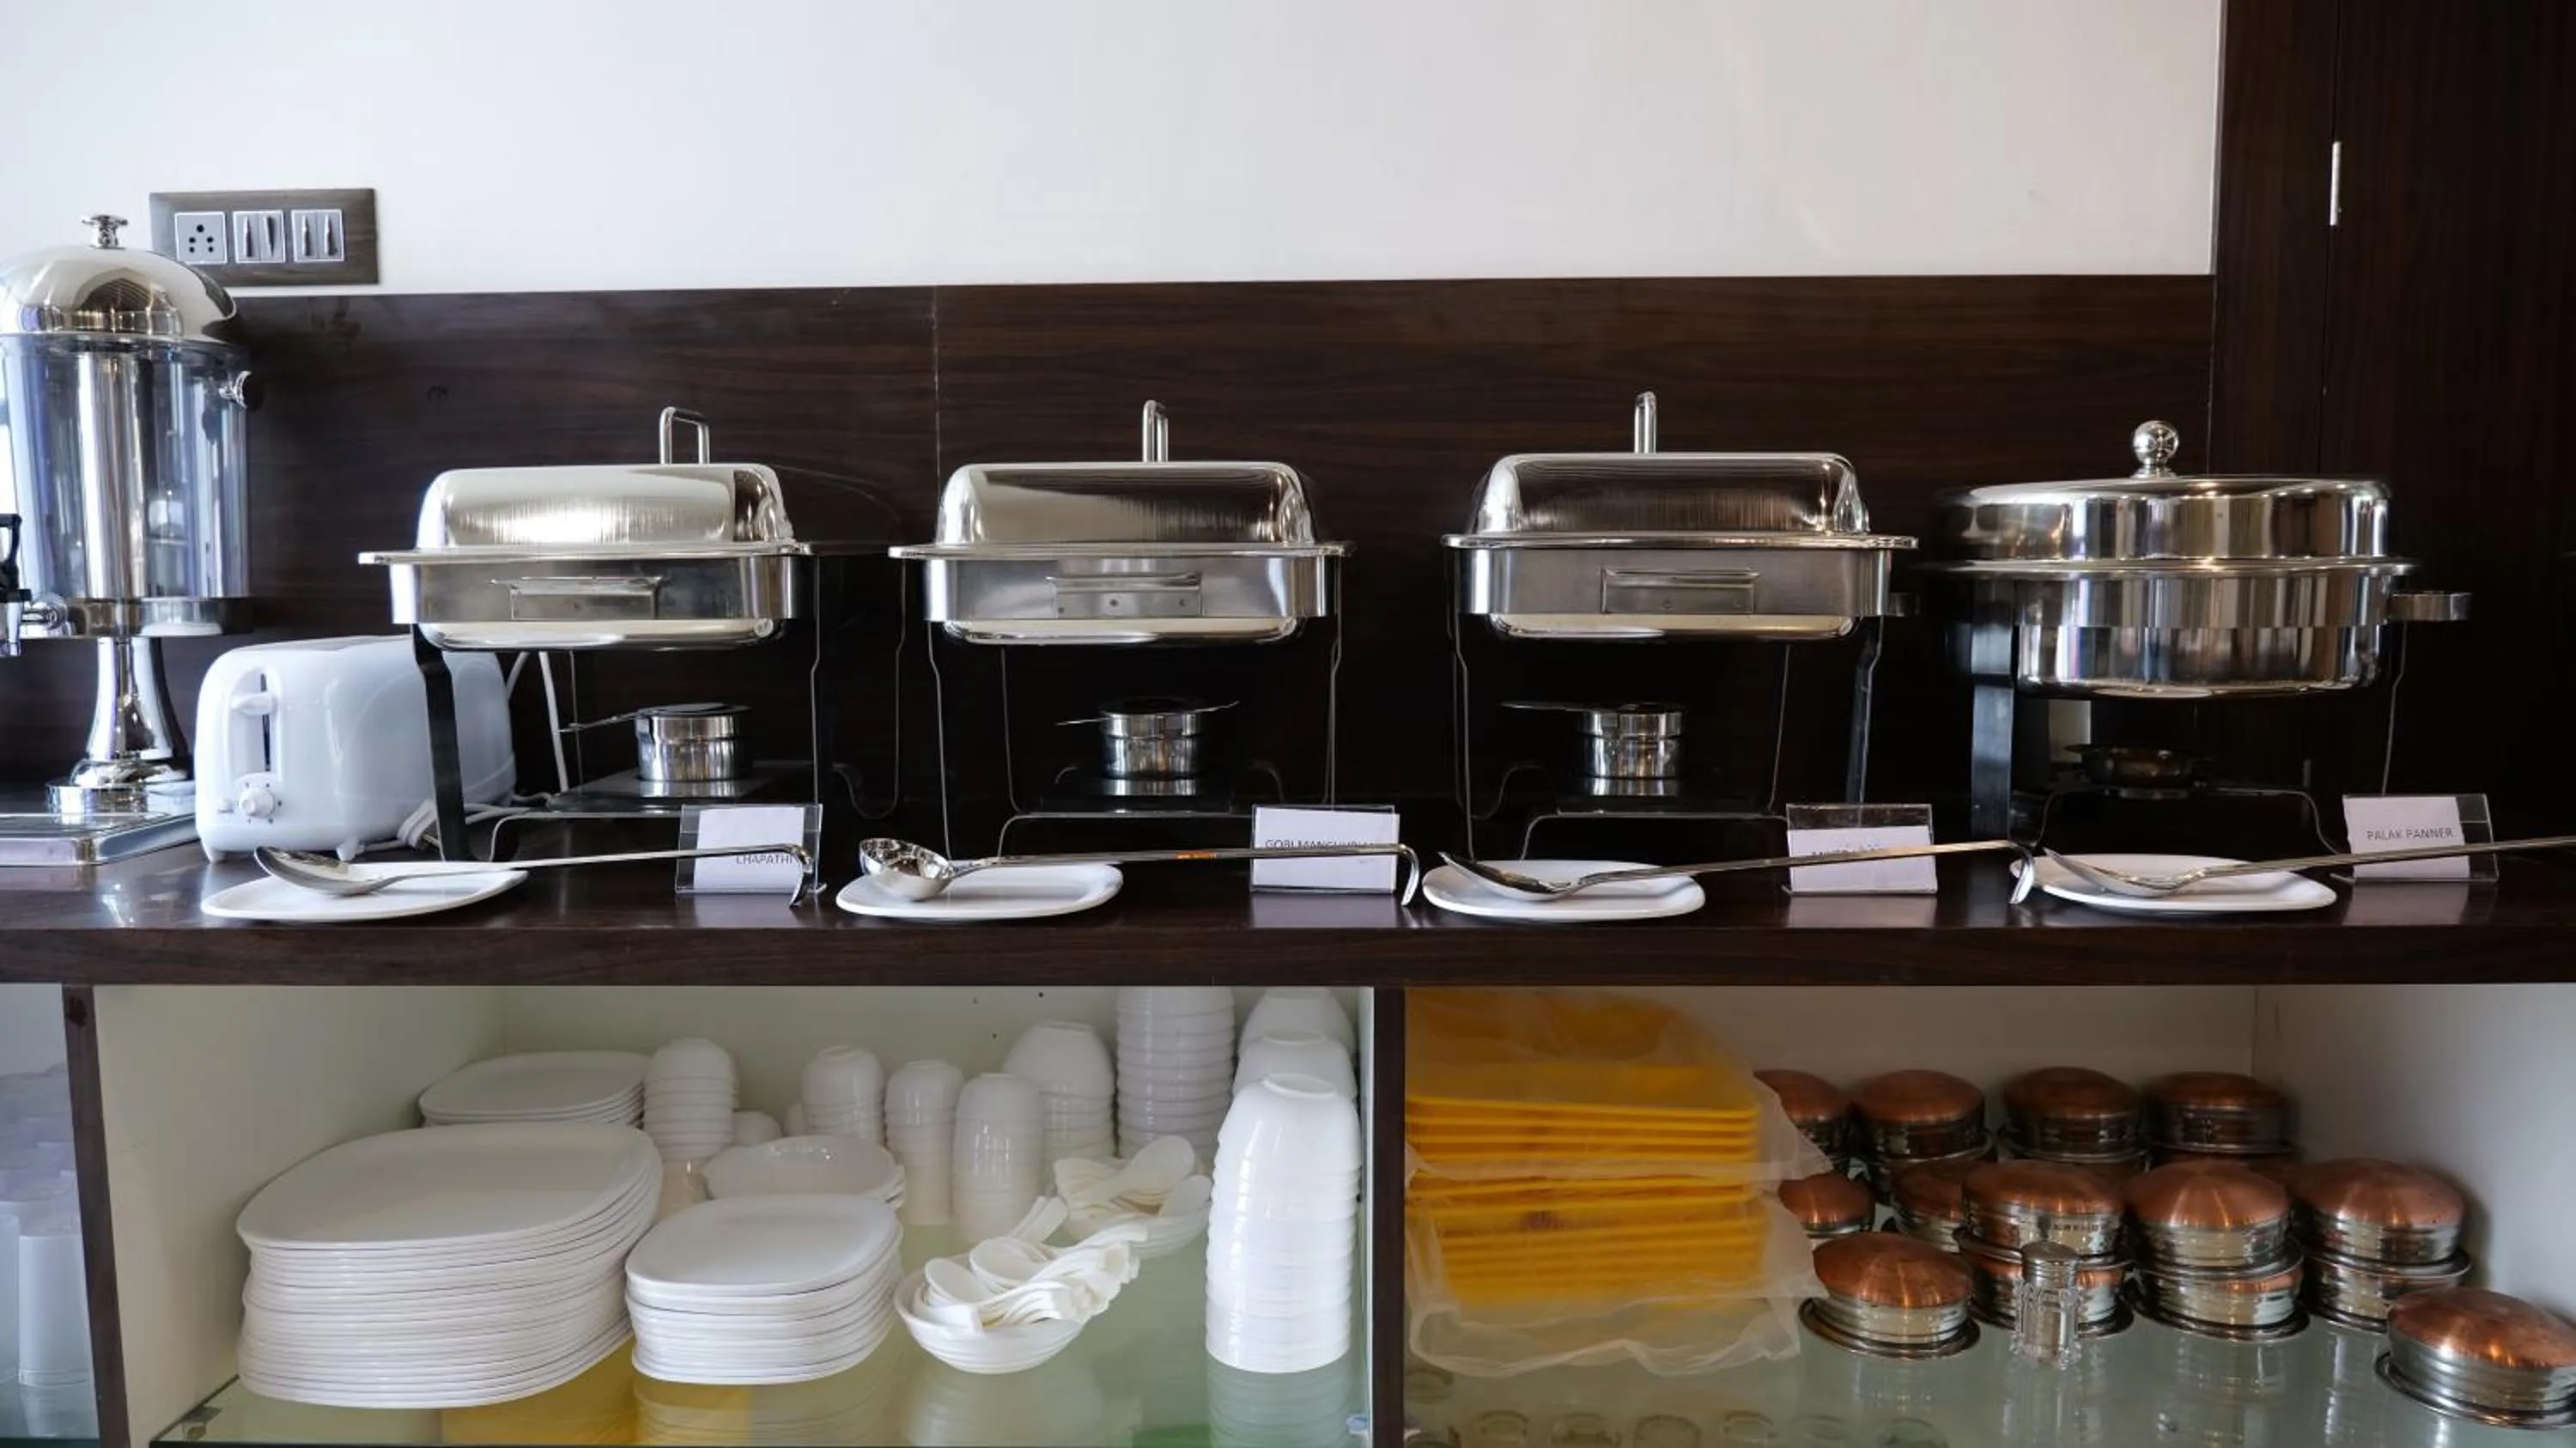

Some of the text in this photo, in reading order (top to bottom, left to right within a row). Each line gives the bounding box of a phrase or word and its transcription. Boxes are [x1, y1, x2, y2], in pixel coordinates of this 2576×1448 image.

[2366, 827, 2453, 841] PALAK PANNER
[1266, 839, 1294, 849] GOBI
